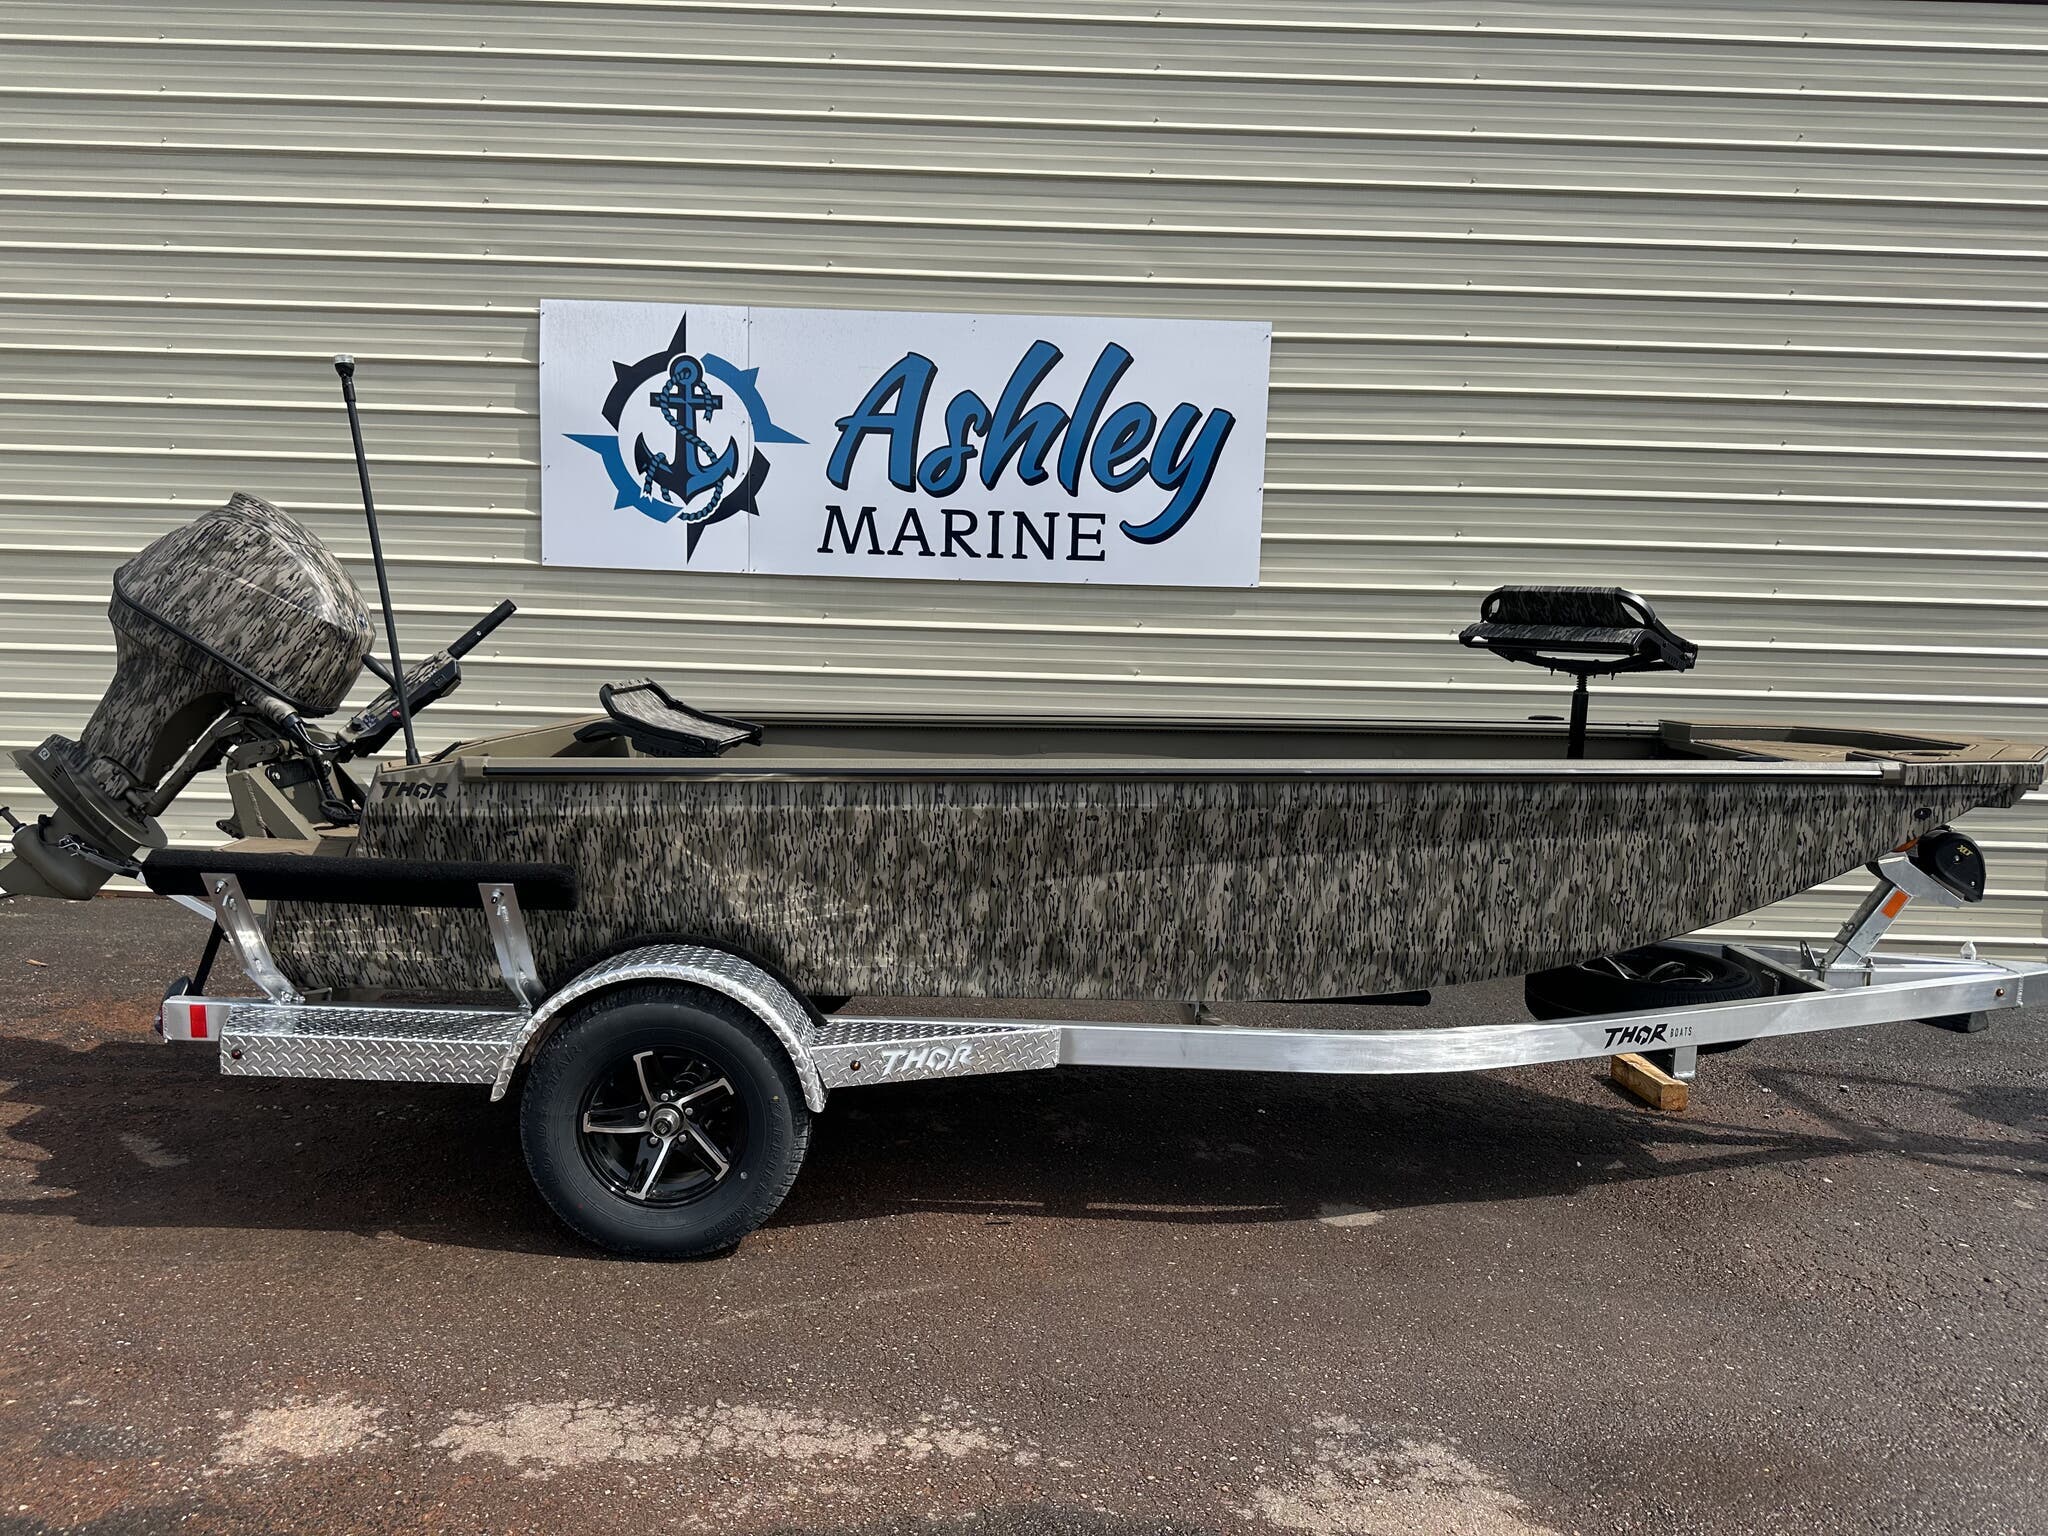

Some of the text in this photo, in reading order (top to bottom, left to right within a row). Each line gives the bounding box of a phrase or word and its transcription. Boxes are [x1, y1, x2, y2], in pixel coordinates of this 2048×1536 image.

[825, 340, 1237, 545] Ashley
[817, 505, 1107, 562] MARINE
[380, 781, 449, 800] THOR
[1604, 1023, 1668, 1049] THOR
[1670, 1026, 1693, 1038] BOATS
[881, 1043, 975, 1077] THOR
